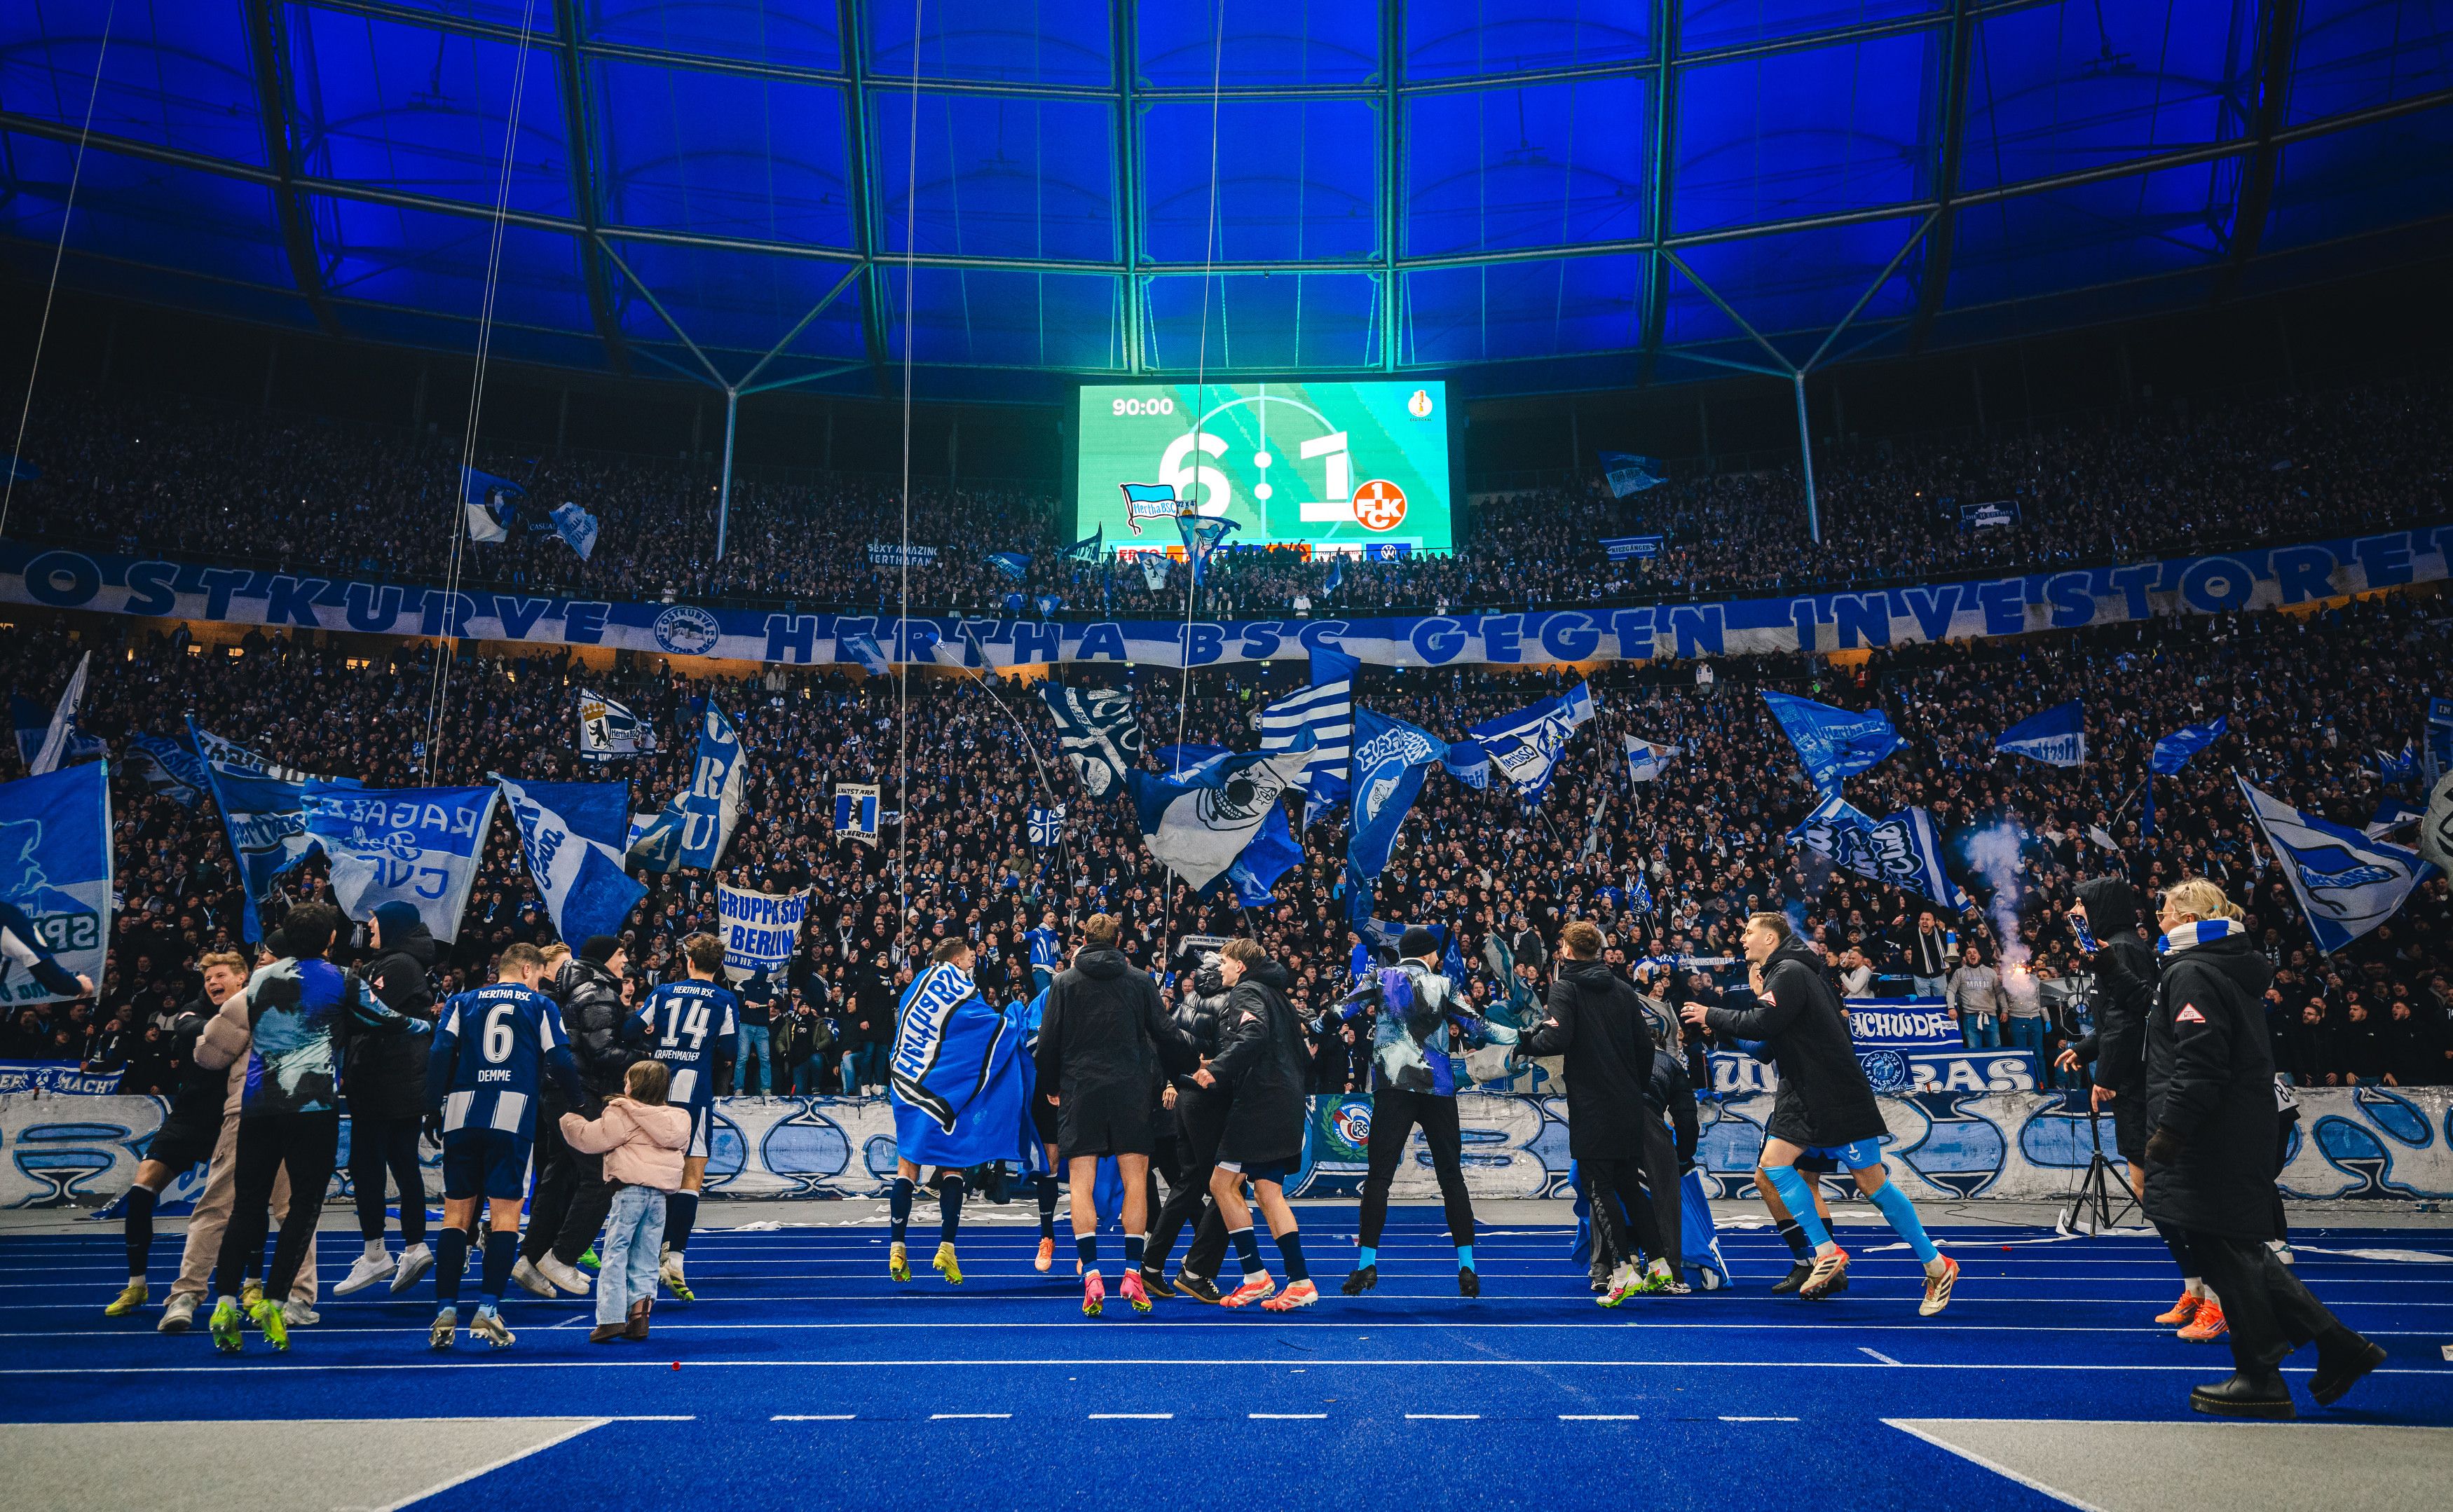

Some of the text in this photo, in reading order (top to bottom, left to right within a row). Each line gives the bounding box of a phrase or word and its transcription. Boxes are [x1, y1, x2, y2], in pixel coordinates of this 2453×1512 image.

[1113, 399, 1173, 415] 90:00
[1159, 432, 1231, 516] 6
[1300, 431, 1353, 522] 1
[1133, 502, 1176, 515] Hertha BSC
[868, 544, 893, 554] SEXY
[1612, 545, 1651, 554] KIEZGÄNGER
[23, 550, 610, 644] OSTKURVE
[764, 614, 1128, 668] HERTHA
[1177, 620, 1349, 667] BSC
[1412, 603, 1726, 664] GEGEN
[661, 609, 714, 628] OSTKURVE
[611, 730, 629, 738] Hertha
[719, 888, 779, 926] GRUPPA
[730, 924, 795, 957] BERLIN
[478, 989, 533, 1001] HERTHA BSC
[673, 985, 715, 998] HERTHA BSC
[661, 997, 711, 1050] 14
[483, 1003, 515, 1064] 6
[1865, 1052, 1899, 1067] WILD BOYS
[478, 1069, 512, 1083] DEMME
[1866, 1069, 1901, 1085] KARLSRUHE
[60, 1076, 119, 1094] MACHT
[1334, 1128, 1353, 1148] FOOTBALL
[1849, 1143, 1858, 1153] 1
